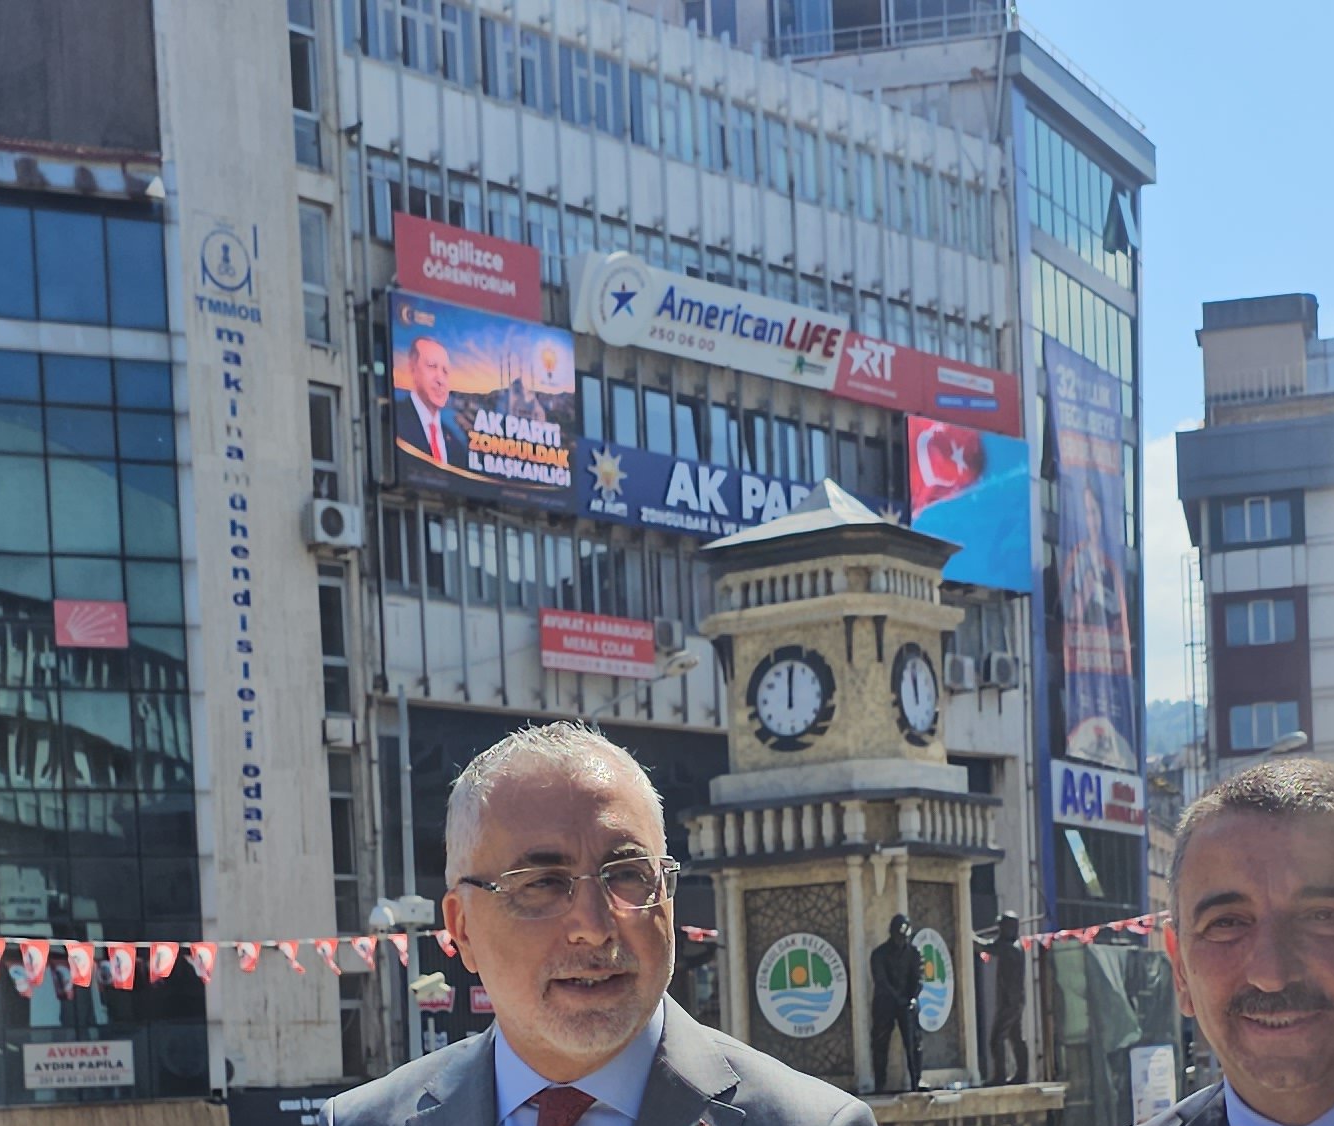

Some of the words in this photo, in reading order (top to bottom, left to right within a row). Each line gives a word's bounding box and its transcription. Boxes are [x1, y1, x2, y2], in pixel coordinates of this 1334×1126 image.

[429, 232, 504, 272] İngilizce
[194, 295, 262, 323] TMMOB
[656, 285, 842, 359] AmericanLIFE
[649, 325, 675, 343] 250
[678, 332, 695, 348] 06
[698, 337, 716, 352] 00
[473, 408, 504, 435] AK
[504, 414, 561, 448] PARTİ
[468, 430, 569, 468] ZONGULDAK
[468, 450, 483, 471] İL
[483, 453, 571, 488] BAŞKANLIĞI
[665, 461, 729, 516] AK
[1060, 768, 1103, 821] AÇI
[34, 1061, 74, 1072] AYDIN
[78, 1059, 124, 1071] PAPİLA
[46, 1046, 110, 1058] AVUKAT
